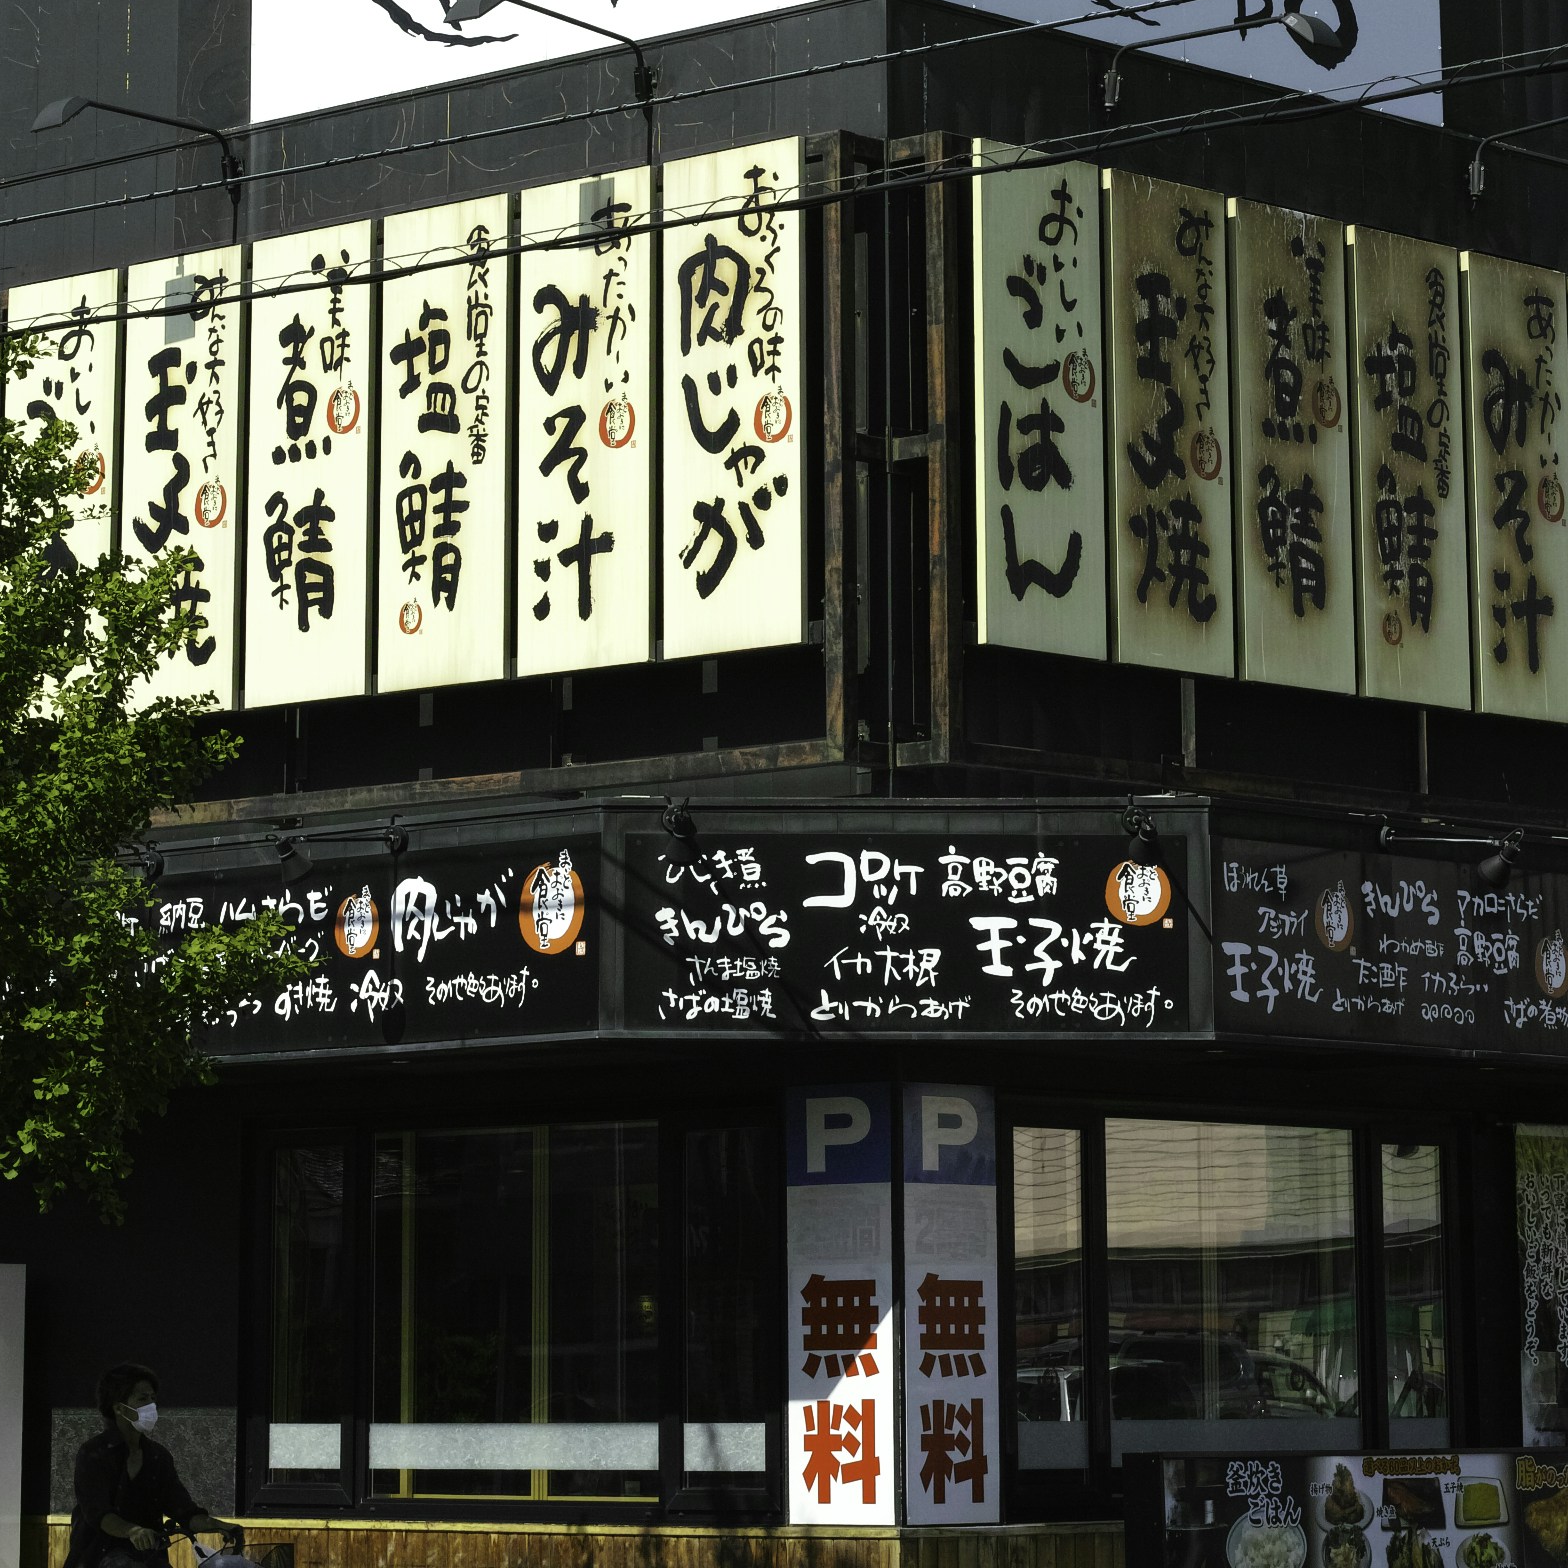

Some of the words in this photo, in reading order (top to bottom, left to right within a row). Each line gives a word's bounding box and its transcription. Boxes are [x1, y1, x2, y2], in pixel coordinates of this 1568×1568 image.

[737, 165, 784, 384] おふくろの味
[1039, 179, 1083, 343] おいしい
[390, 299, 470, 611] 塩鯖
[532, 283, 615, 622] みそ汁
[677, 233, 789, 600] 肉じゃが
[999, 254, 1082, 602] ごはん
[1127, 272, 1217, 624] 玉子焼
[264, 312, 336, 633] 煮鯖
[1482, 348, 1555, 676] みそ汁
[160, 898, 205, 935] 納豆
[390, 868, 514, 963] 肉じゃが
[802, 849, 924, 908] コロッケ
[938, 845, 1059, 904] 高野豆腐
[1223, 862, 1288, 901] ほうれん草
[1360, 880, 1441, 925] きんぴら
[1457, 890, 1543, 924] マカロニさらだ
[655, 901, 791, 948] きんぴら
[859, 906, 910, 942] 冷奴
[969, 916, 1137, 987] 玉子焼
[686, 955, 781, 986] さんま塩焼
[824, 945, 941, 987] イカ大根
[1221, 941, 1323, 1014] 玉子焼
[1257, 906, 1309, 939] アジフライ
[1453, 922, 1520, 975] 高野豆腐
[274, 976, 338, 1021] すき焼
[350, 970, 403, 1023] 冷奴
[658, 988, 777, 1020] さばの塩焼
[810, 989, 972, 1020] とりからあげ
[806, 1096, 871, 1173] P
[922, 1096, 978, 1172] P
[801, 1273, 881, 1505] 無料
[917, 1272, 988, 1504] 無料
[1226, 1460, 1283, 1496] 釜炊き
[1248, 1496, 1301, 1528] ごはん
